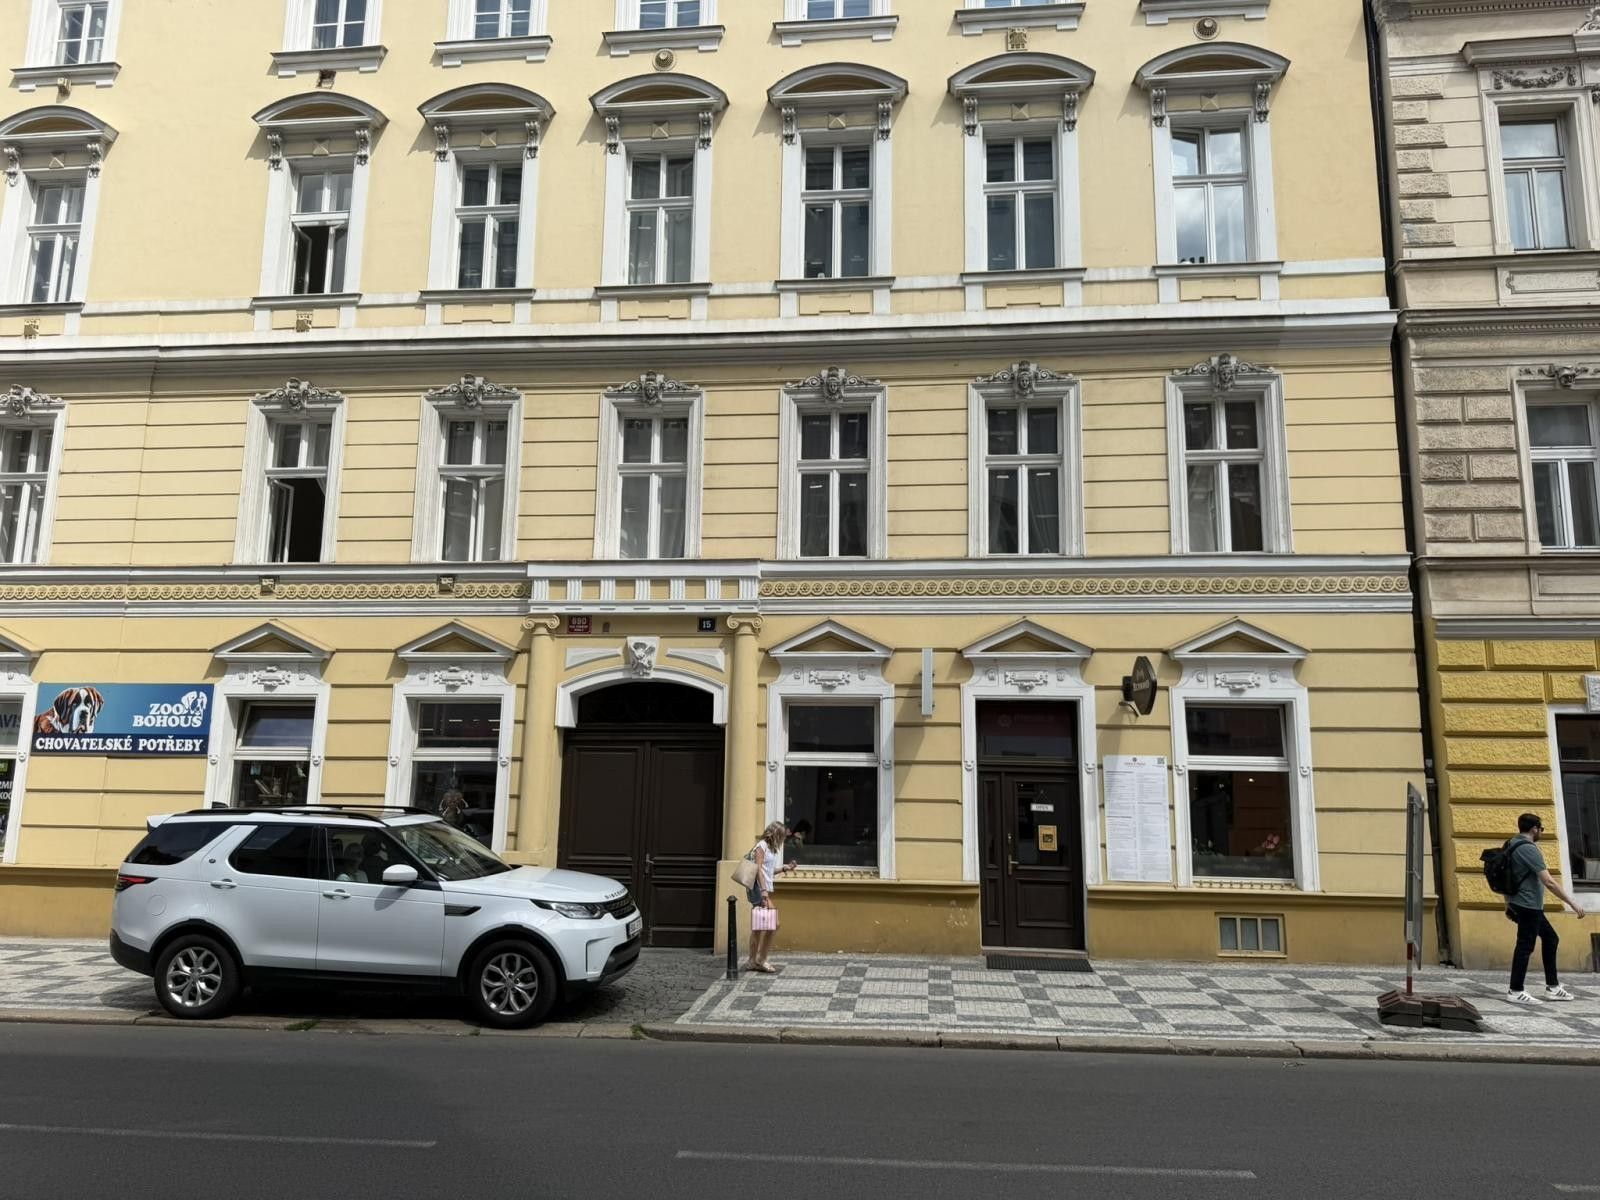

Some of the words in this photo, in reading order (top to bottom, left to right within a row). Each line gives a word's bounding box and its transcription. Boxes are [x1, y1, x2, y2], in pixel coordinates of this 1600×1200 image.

[702, 620, 712, 629] 15
[149, 703, 184, 715] ZOO
[132, 712, 202, 727] BOHOUŠ
[35, 735, 133, 750] CHOVATELSKÉ
[138, 735, 203, 751] POTŘEBY
[604, 888, 626, 899] DISCO
